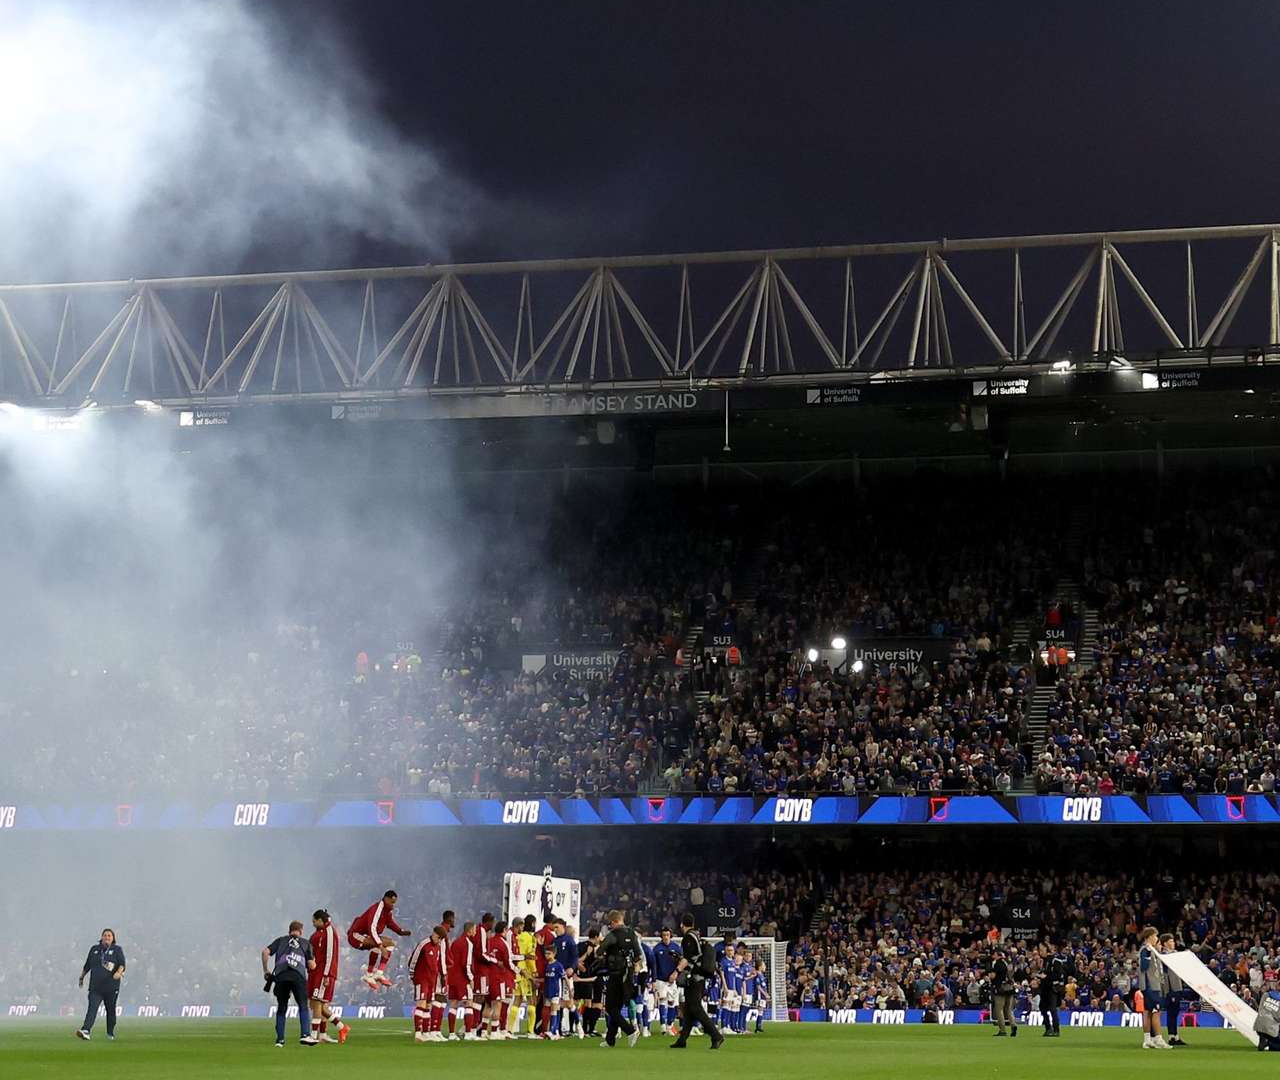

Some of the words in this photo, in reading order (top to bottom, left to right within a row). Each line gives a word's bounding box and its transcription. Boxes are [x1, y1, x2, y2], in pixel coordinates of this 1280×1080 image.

[1161, 371, 1200, 381] University
[991, 378, 1029, 388] University
[824, 388, 860, 398] University
[991, 387, 999, 395] of
[1000, 385, 1027, 395] Suffolk
[634, 393, 697, 410] STAND
[824, 395, 831, 403] of
[833, 394, 858, 403] Suffolk
[1046, 629, 1064, 638] SU4
[713, 636, 732, 646] SU3
[854, 648, 923, 662] University
[553, 654, 619, 668] University
[233, 803, 269, 826] COYB
[503, 800, 539, 823] COYB
[774, 798, 812, 822] COYB
[1063, 797, 1101, 822] COYB
[718, 907, 736, 918] SL3
[1012, 908, 1031, 918] SL4
